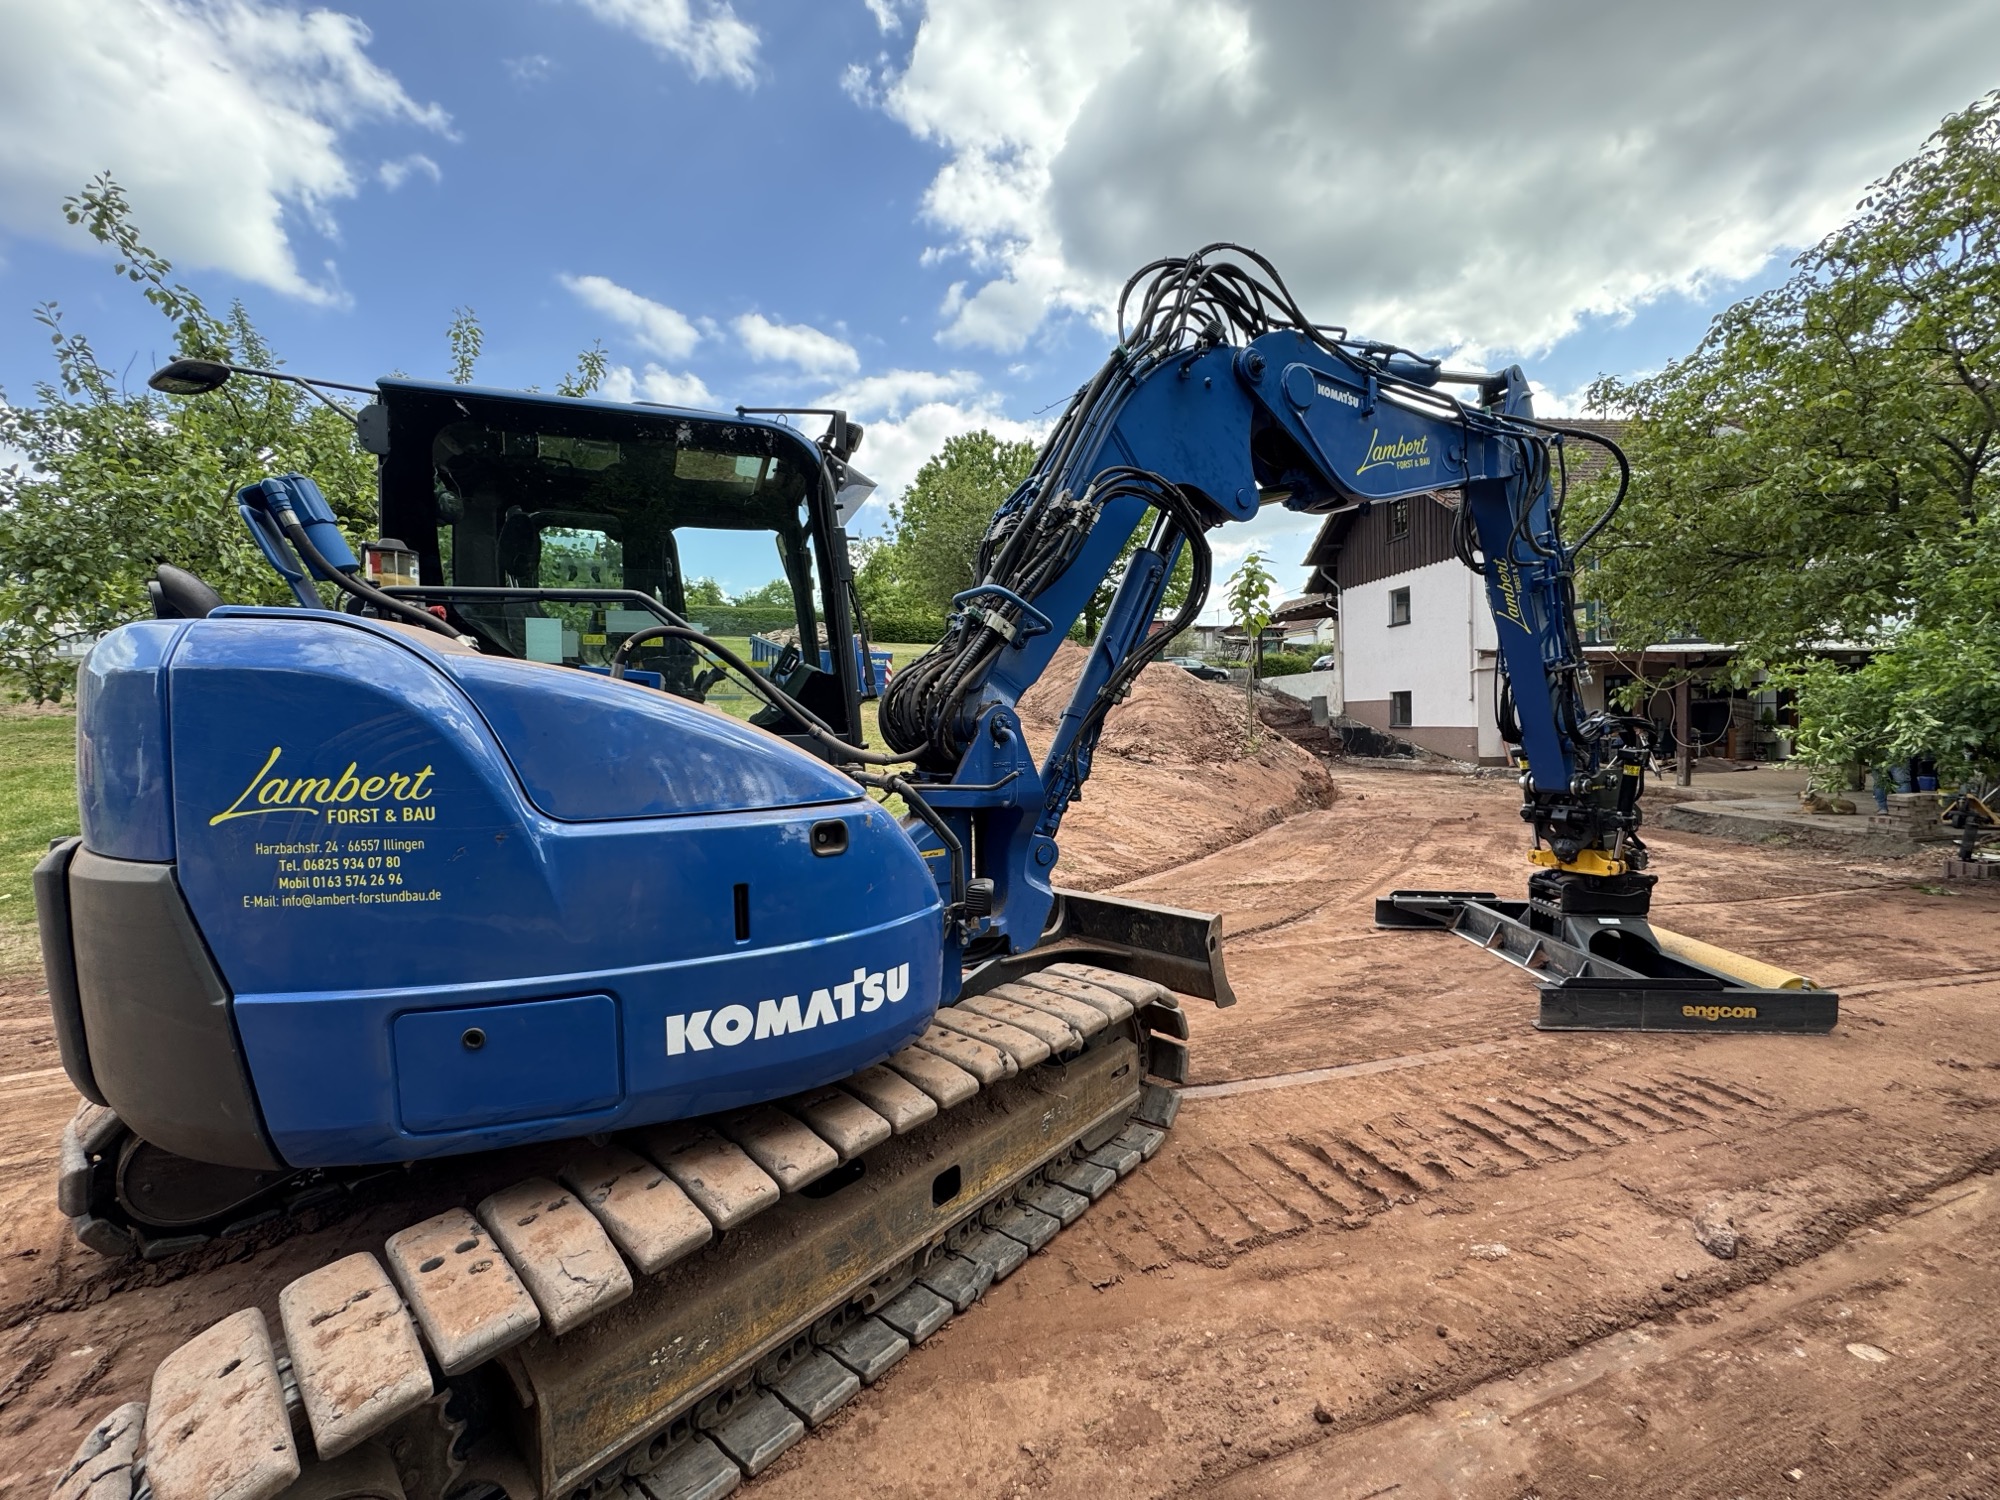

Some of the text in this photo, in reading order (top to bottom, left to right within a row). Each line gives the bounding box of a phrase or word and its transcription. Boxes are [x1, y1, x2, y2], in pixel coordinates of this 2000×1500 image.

[1317, 383, 1359, 409] KOMATSU
[1356, 428, 1428, 475] Lambert
[1396, 459, 1414, 470] FORST
[1419, 457, 1431, 466] BAU
[1512, 574, 1523, 593] FORST
[1492, 557, 1532, 634] Lambert
[209, 746, 435, 826] Lambert
[327, 806, 436, 824] FORST & BAU
[255, 842, 322, 855] Harzbachstr.
[325, 841, 338, 853] 24
[347, 839, 380, 852] 66557
[383, 838, 425, 853] Illingen
[279, 856, 401, 871] Tel. 06825 934 07 80
[279, 873, 403, 889] Mobil 0163 574 26 96
[243, 889, 442, 908] E-Mail: info@lambert-forstundbau.de
[666, 962, 909, 1056] KOMATSU
[1682, 1005, 1757, 1021] engcon
